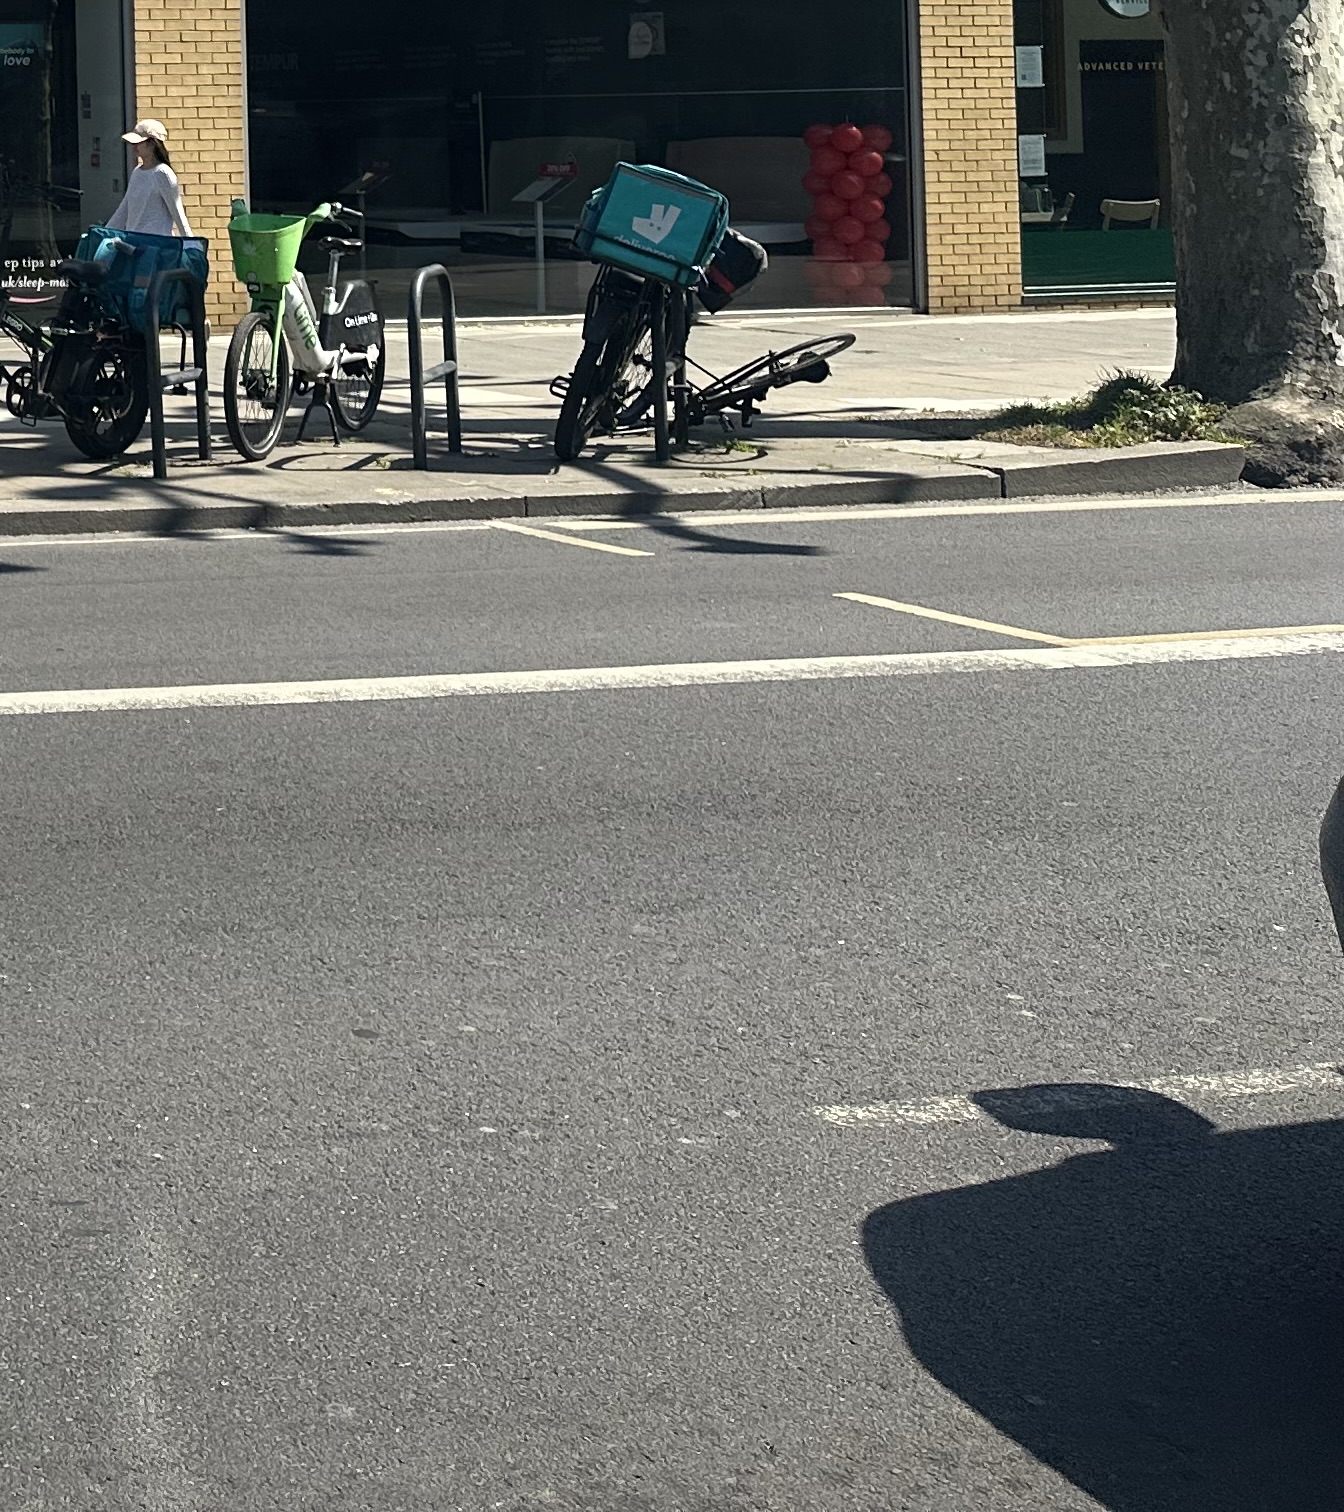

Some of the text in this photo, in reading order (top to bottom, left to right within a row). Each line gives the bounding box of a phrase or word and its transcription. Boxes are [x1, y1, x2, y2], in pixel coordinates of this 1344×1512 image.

[3, 54, 31, 66] love
[1077, 61, 1165, 71] ADVANCED VETE
[22, 257, 45, 272] tips
[294, 301, 317, 350] Lime
